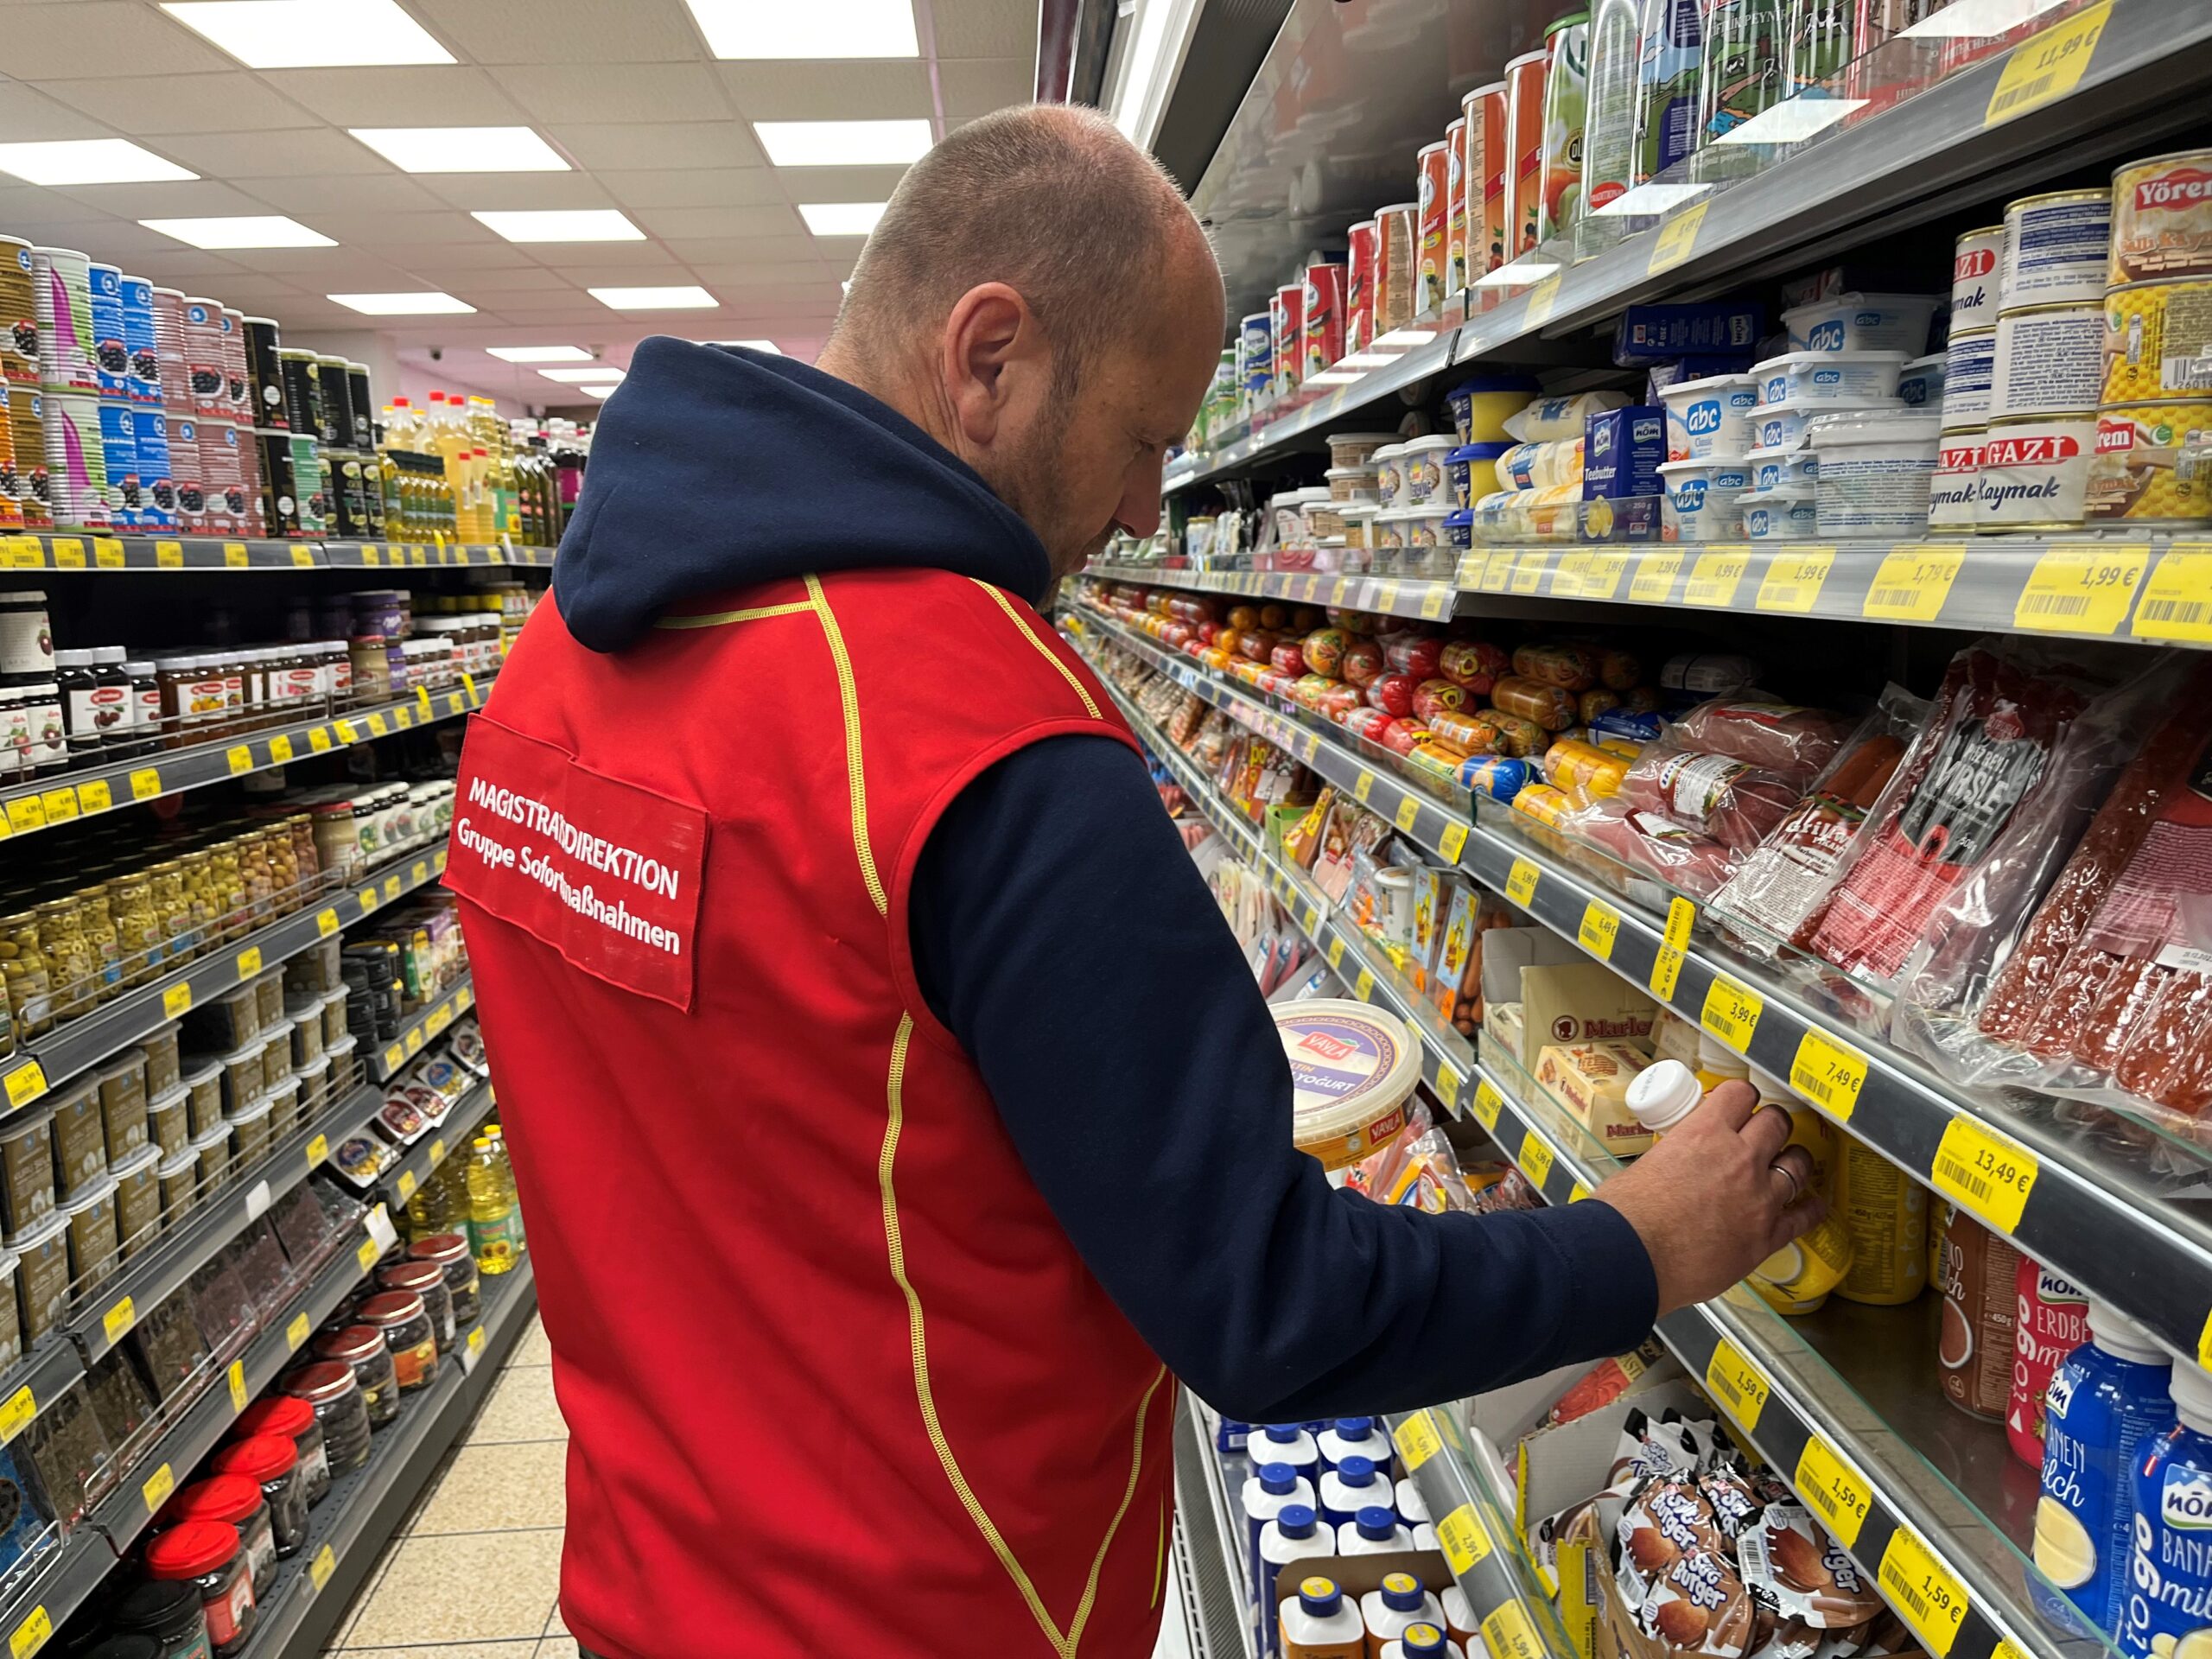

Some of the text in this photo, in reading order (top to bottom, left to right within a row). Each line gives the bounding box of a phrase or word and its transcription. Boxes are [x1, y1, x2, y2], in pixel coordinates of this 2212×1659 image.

[2035, 25, 2101, 70] 11,99 €
[1810, 324, 1841, 352] abc
[1816, 372, 1840, 383] abc
[1732, 396, 1756, 406] abc
[1769, 378, 1786, 403] abc
[1688, 405, 1719, 432] abc
[1765, 424, 1781, 445] abc
[2098, 430, 2131, 448] rem
[1585, 467, 1617, 481] Teebutter
[1719, 475, 1742, 486] abc
[1979, 475, 2061, 512] Kaymak
[1751, 512, 1768, 533] abc
[1792, 509, 1815, 518] abc
[1715, 564, 1741, 578] 0,99 €
[1794, 565, 1827, 582] 1,99 €
[1912, 564, 1956, 585] 1,79 €
[2080, 567, 2139, 589] 1,99 €
[457, 817, 516, 870] Gruppe
[1730, 1002, 1757, 1027] 3,99 €
[1309, 1036, 1348, 1058] YAYLA
[1296, 1075, 1356, 1092] YOĞURT
[1826, 1061, 1860, 1093] 7,49 €
[1371, 1113, 1400, 1140] YAYLA
[1974, 1149, 2030, 1193] 13,49 €
[2037, 1306, 2089, 1344] ERDBE
[1737, 1370, 1764, 1405] 1,59 €
[1832, 1478, 1866, 1519] 1,59 €
[2133, 1511, 2160, 1599] go
[1671, 1559, 1727, 1611] Burger
[1923, 1575, 1962, 1624] 1,59 €
